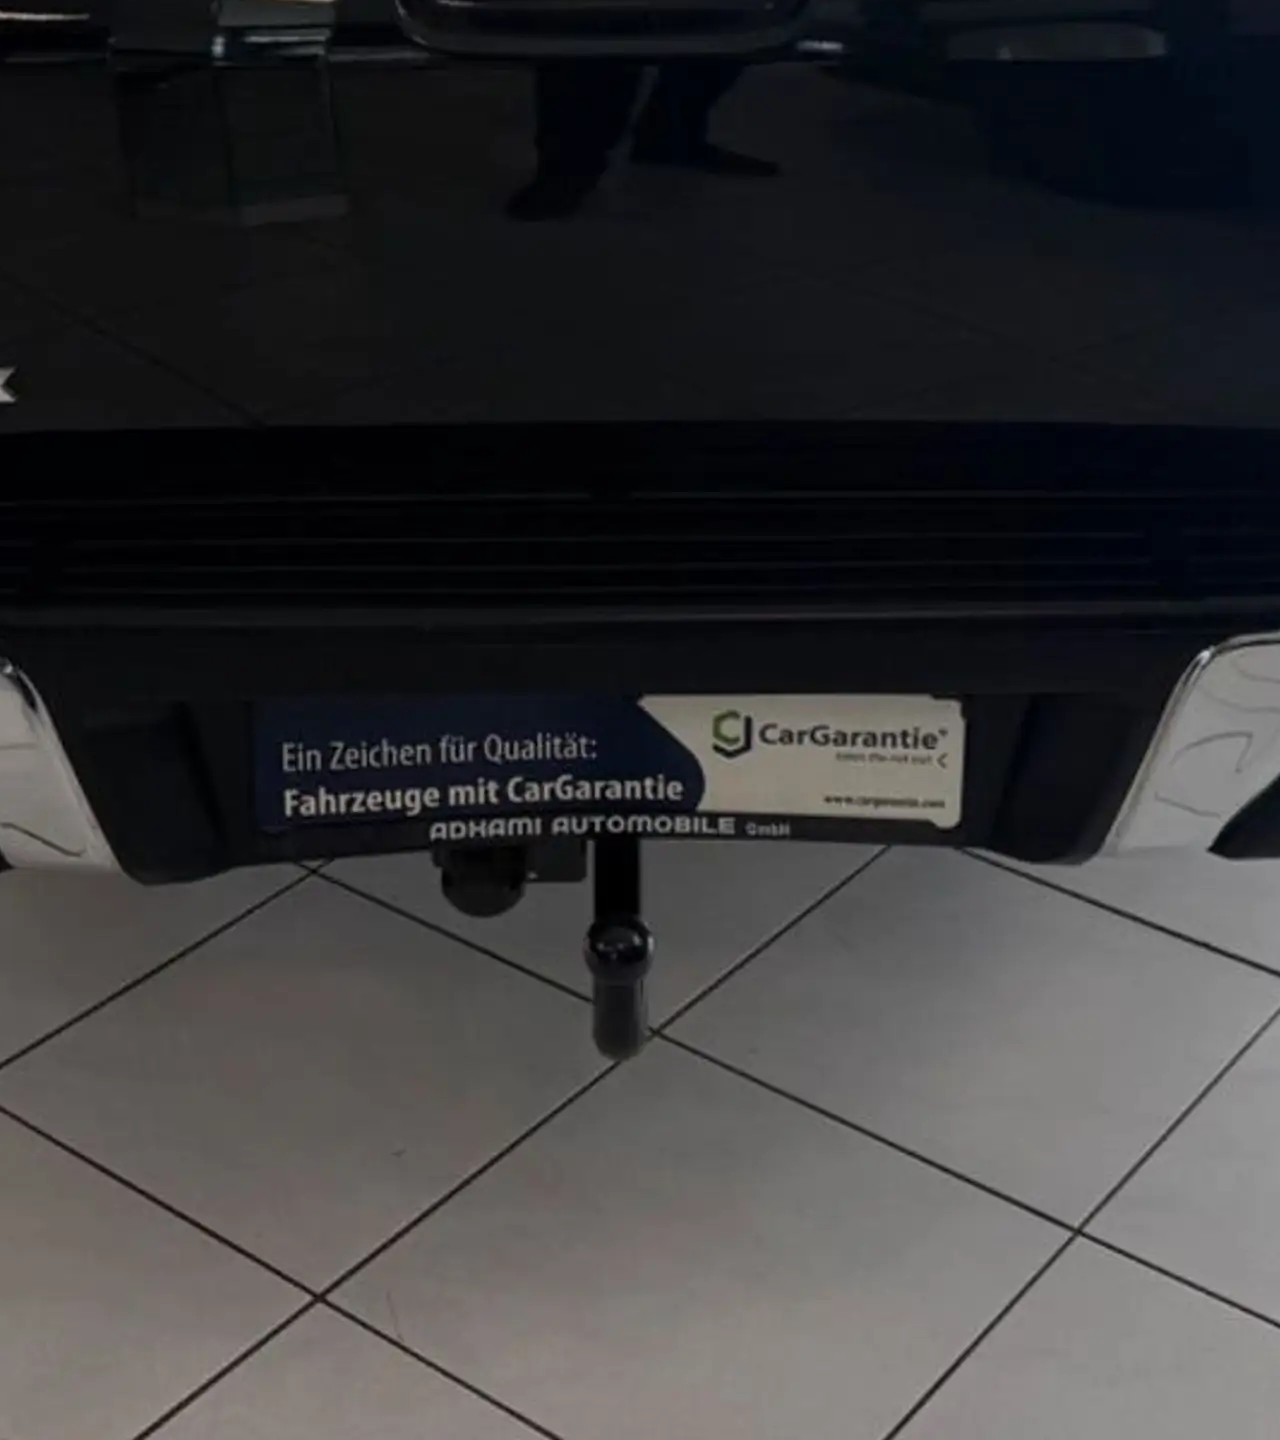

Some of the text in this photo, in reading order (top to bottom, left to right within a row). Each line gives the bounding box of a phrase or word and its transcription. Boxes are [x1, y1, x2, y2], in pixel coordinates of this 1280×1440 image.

[281, 732, 598, 773] Ein Zeichen für Qualität:
[284, 773, 686, 818] Fahrzeuge mit CarGarantie
[428, 815, 791, 842] ADHAMI AUTOMOBILE GmbH
